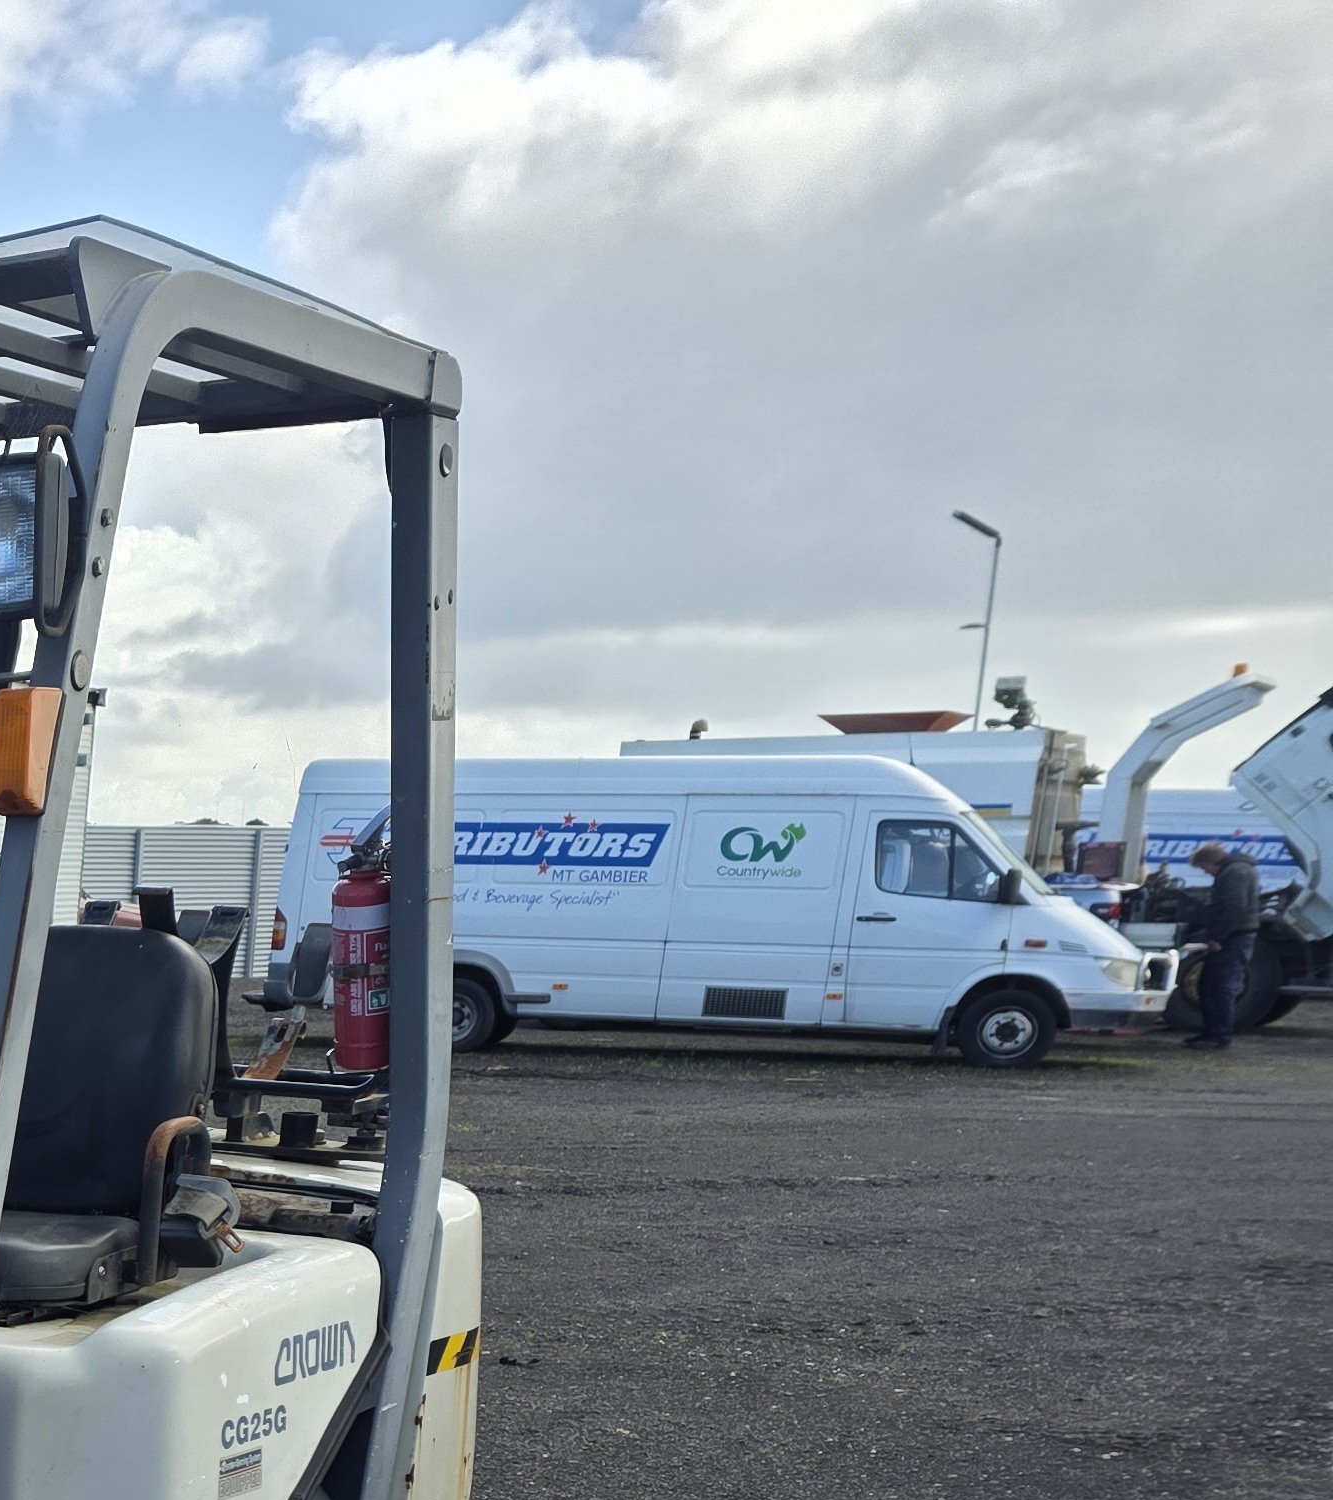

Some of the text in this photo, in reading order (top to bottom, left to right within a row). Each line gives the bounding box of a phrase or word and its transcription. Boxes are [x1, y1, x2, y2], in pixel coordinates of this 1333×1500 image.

[454, 831, 657, 858] RIBUTORS
[552, 869, 648, 883] MT GAMBIER
[717, 865, 802, 880] Countrywide
[484, 888, 543, 911] Beverage
[274, 1320, 356, 1386] CROWN
[221, 1405, 287, 1449] CG25G
[219, 1469, 262, 1498] EQUIPPED
